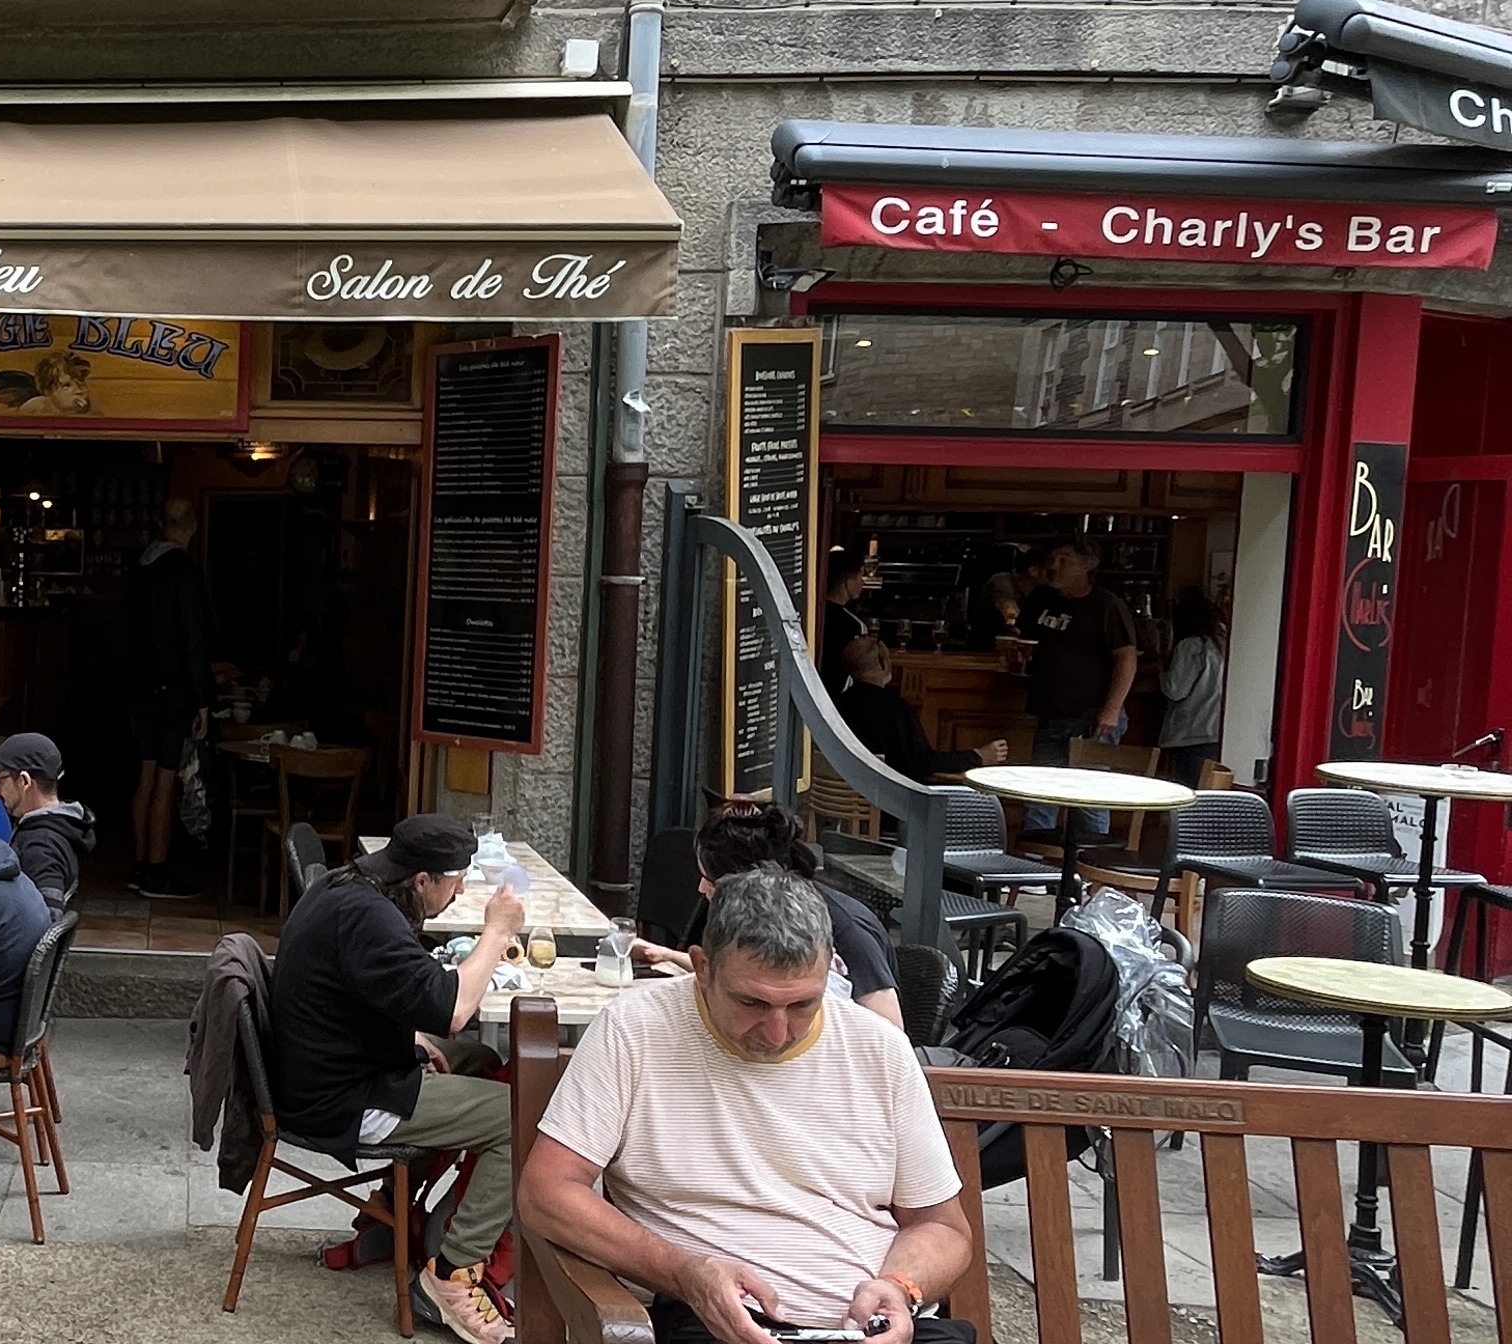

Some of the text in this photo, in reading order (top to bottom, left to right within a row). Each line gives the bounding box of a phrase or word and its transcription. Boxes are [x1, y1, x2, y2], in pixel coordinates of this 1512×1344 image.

[869, 196, 1000, 238] Café
[1101, 205, 1324, 259] Charly's
[1345, 215, 1442, 255] Bar
[307, 253, 627, 301] Salon de Thé
[947, 1086, 1015, 1108] VILLE
[1028, 1089, 1060, 1111] DE
[1075, 1094, 1149, 1117] SAINT
